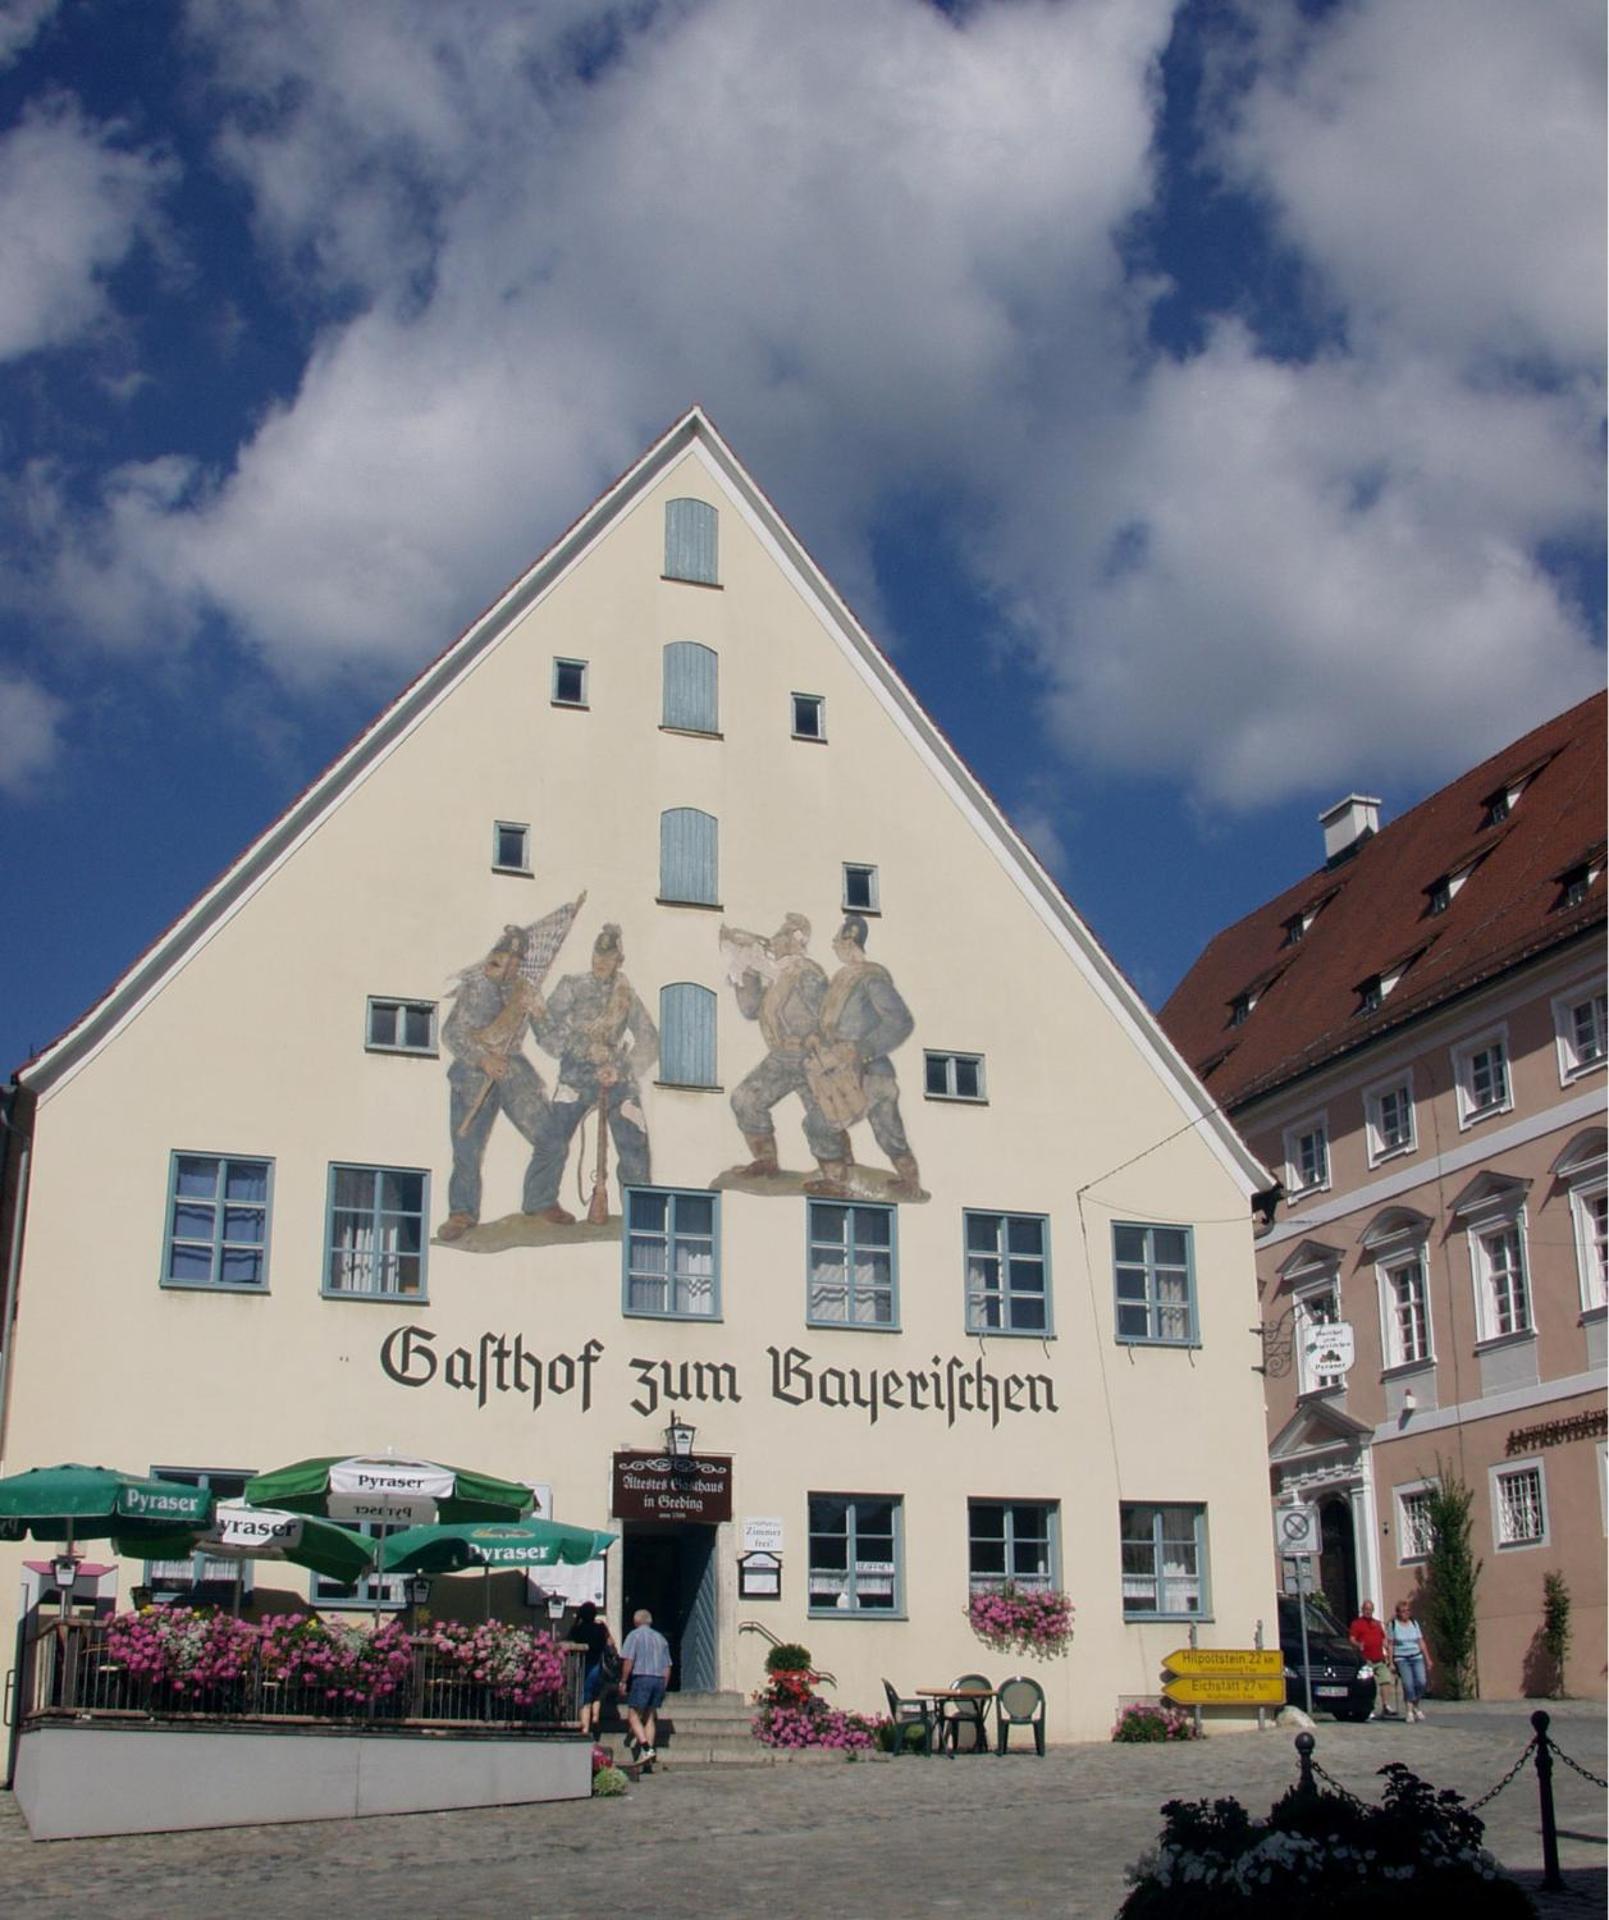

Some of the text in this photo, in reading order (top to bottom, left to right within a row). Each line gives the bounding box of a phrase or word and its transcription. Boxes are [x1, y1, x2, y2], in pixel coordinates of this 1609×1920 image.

[629, 1357, 742, 1418] zum
[358, 1474, 425, 1491] Pyraser
[127, 1488, 199, 1513] Pyraser
[644, 1494, 655, 1508] in
[217, 1516, 297, 1538] yraser
[746, 1526, 782, 1537] Zimmer
[1248, 1652, 1262, 1664] 22
[1191, 1679, 1240, 1692] Eichstätt
[1243, 1680, 1257, 1692] 27
